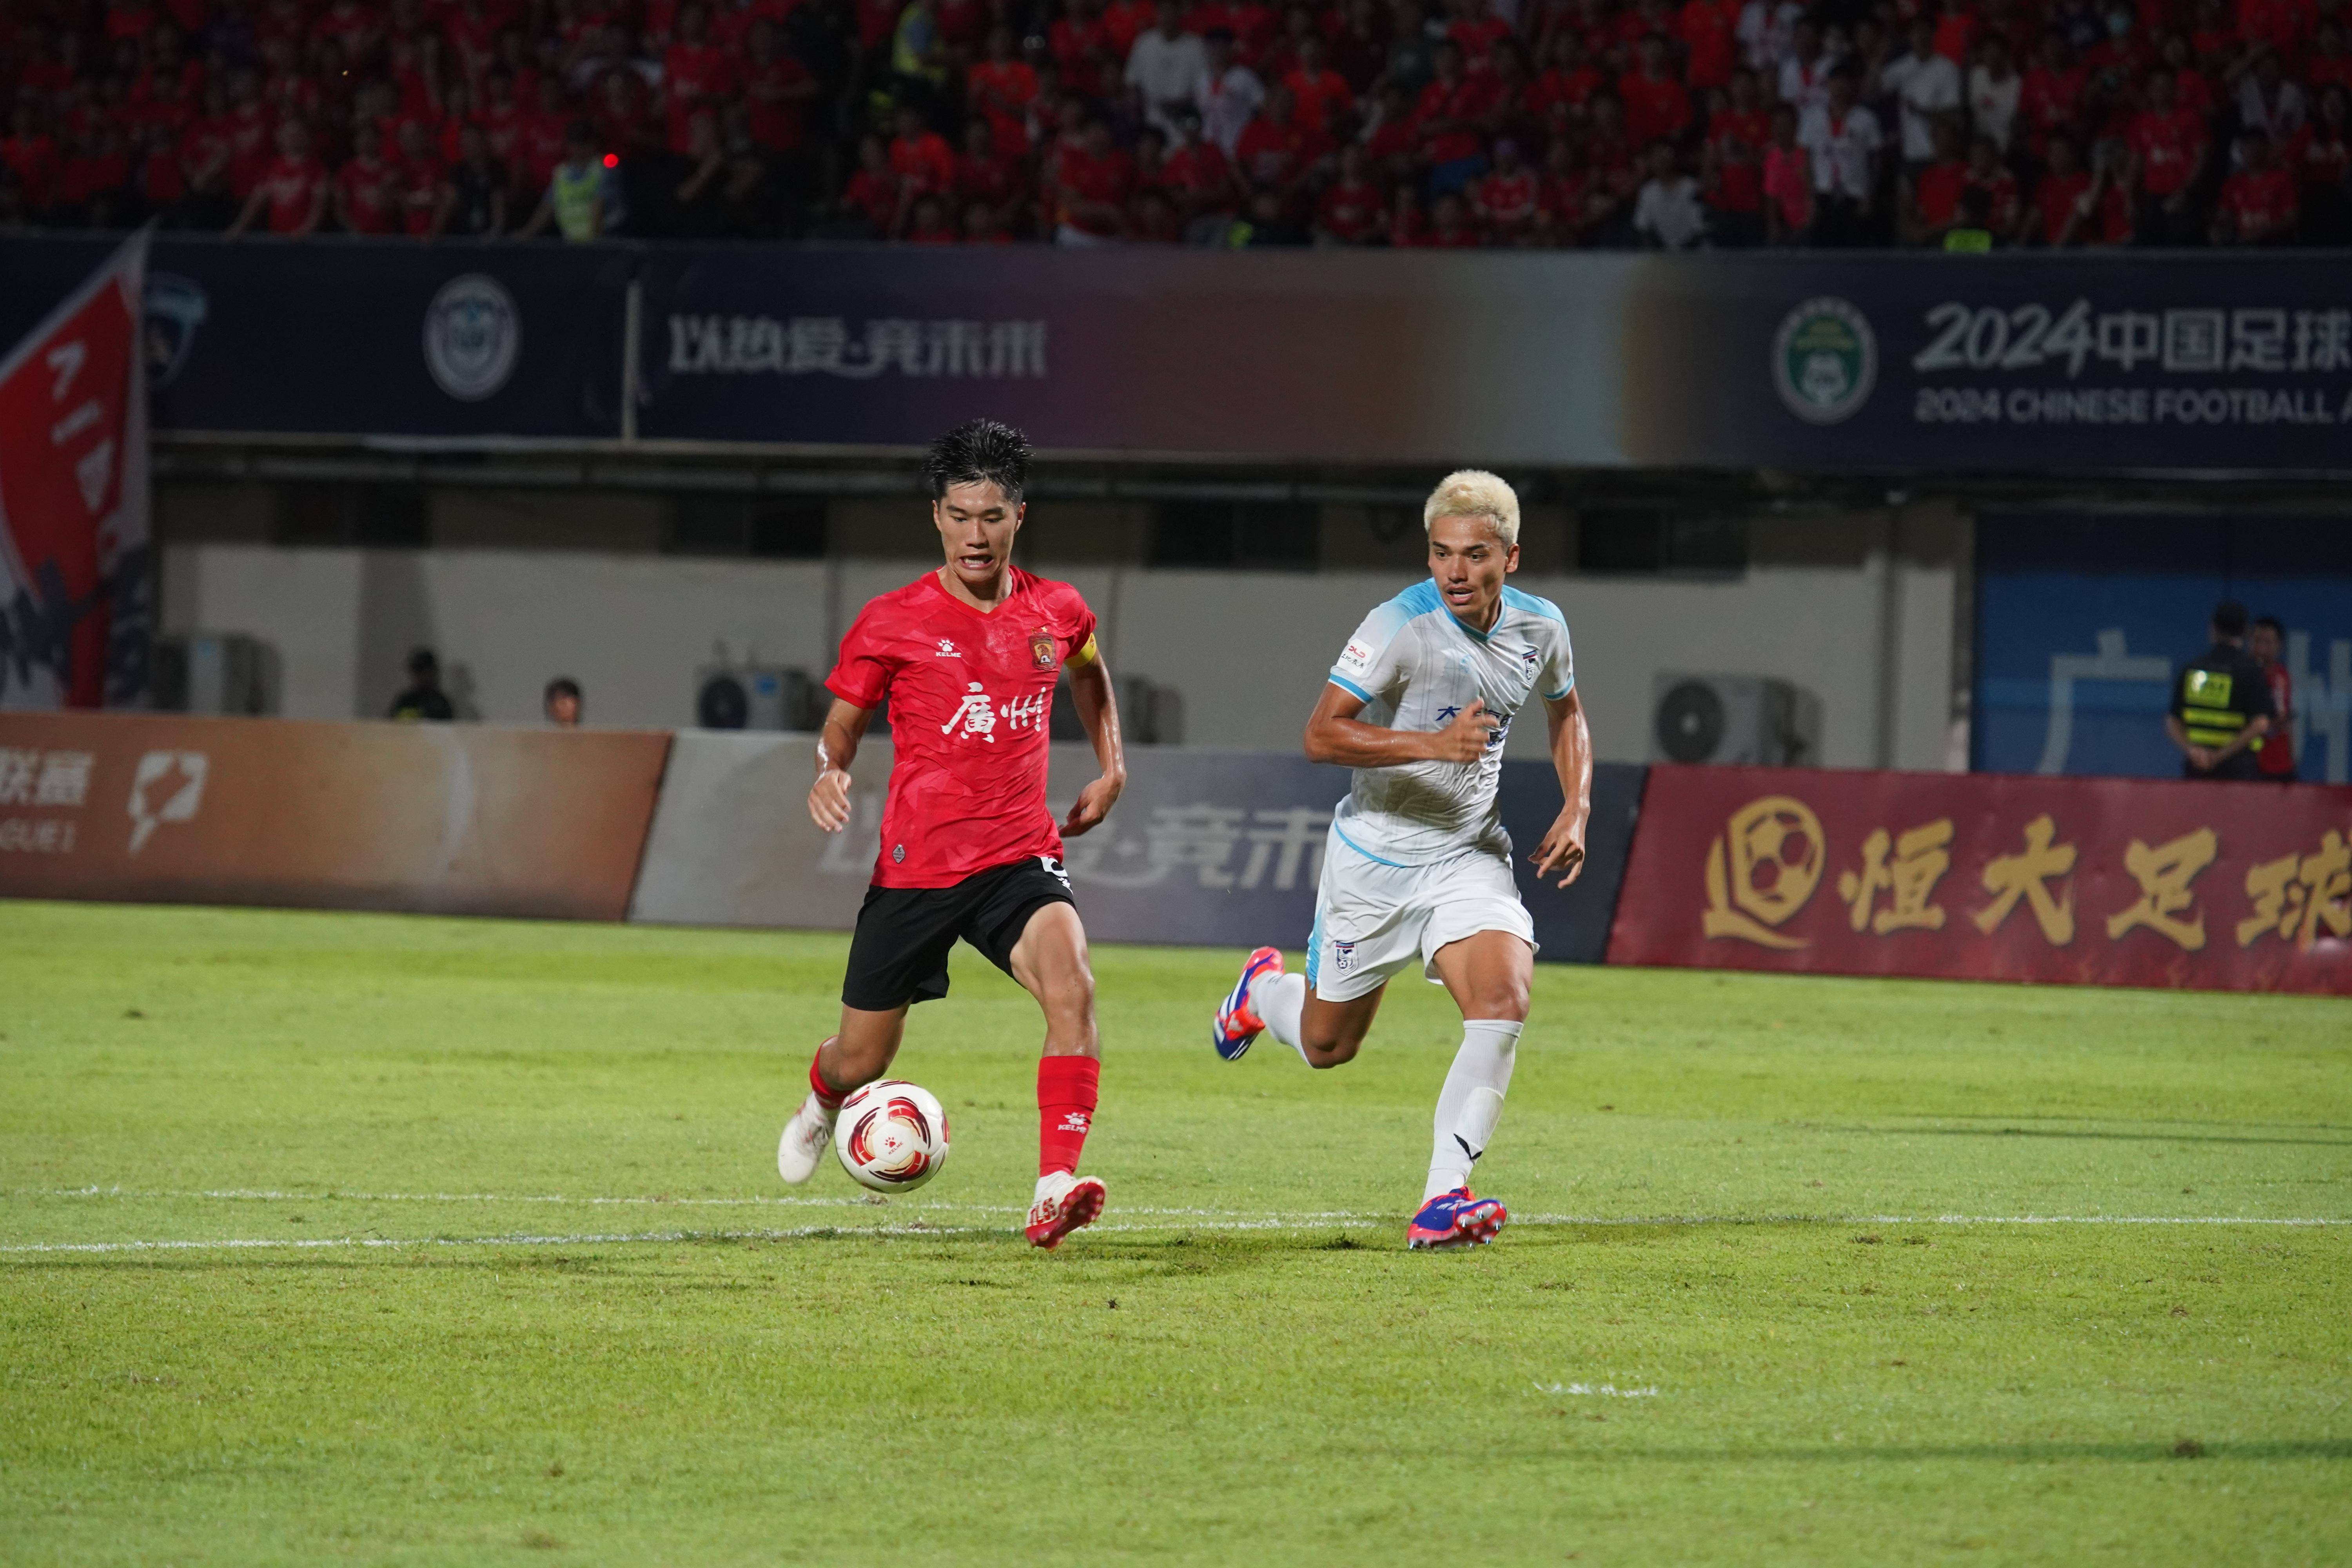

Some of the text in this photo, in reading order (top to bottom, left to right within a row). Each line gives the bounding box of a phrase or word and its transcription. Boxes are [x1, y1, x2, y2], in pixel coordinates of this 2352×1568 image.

[1915, 388, 2001, 423] 2024
[2007, 388, 2149, 424] CHINESE
[2154, 387, 2334, 424] FOOTBALL
[1838, 817, 2352, 953] 恒大足球
[888, 1142, 903, 1155] KELME
